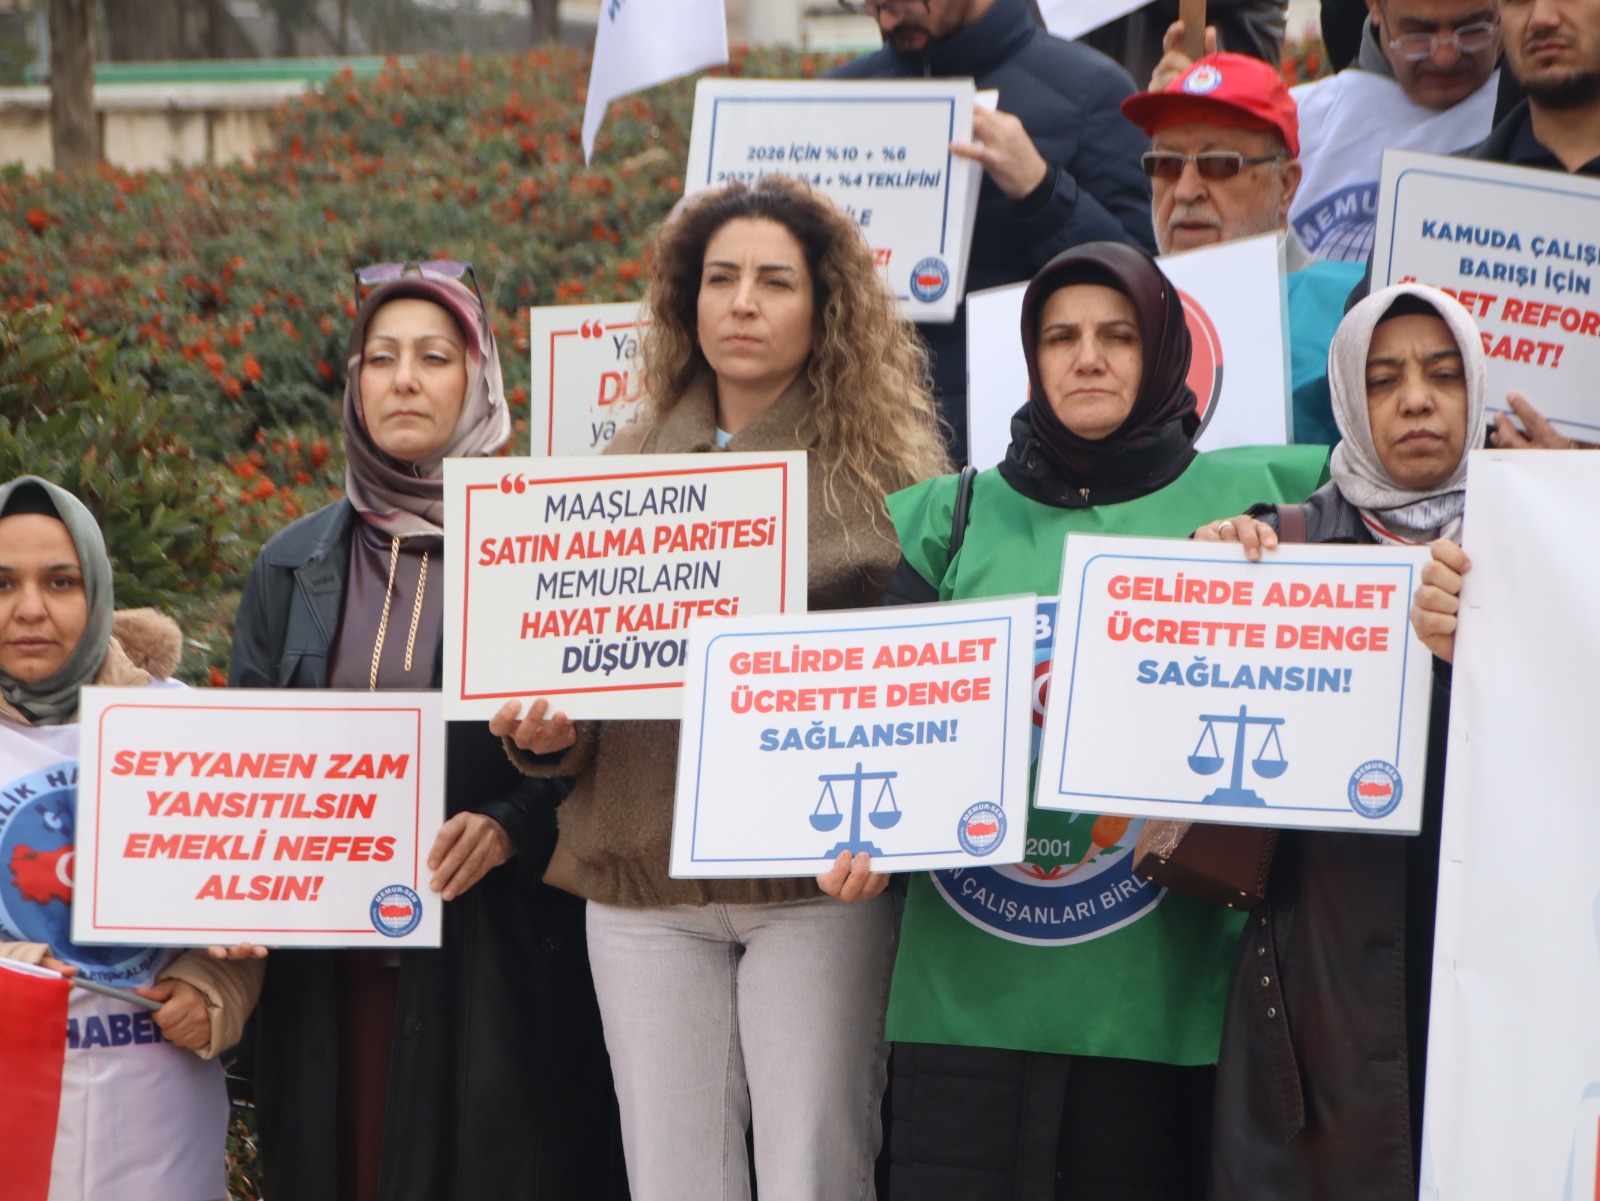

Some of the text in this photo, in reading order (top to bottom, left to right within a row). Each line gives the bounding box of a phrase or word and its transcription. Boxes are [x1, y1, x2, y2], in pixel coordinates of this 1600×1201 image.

[747, 142, 907, 163] 2026 İÇİN %10 + %6
[839, 172, 863, 187] %4
[867, 169, 942, 187] TEKLİFİNİ
[1421, 219, 1600, 266] KAMUDA ÇALIŞ
[1459, 257, 1591, 295] BARIŞI İÇİN
[1501, 297, 1600, 337] REFOR
[544, 484, 708, 524] MAAŞLARIN
[478, 516, 777, 567] SATIN ALMA PARİTESİ
[535, 560, 721, 601] MEMURLARIN
[1107, 572, 1397, 609] GELİRDE ADALET
[520, 596, 739, 640] HAYAT KALİTESİ
[1107, 611, 1389, 652] ÜCRETTE DENGE
[729, 637, 997, 676] GELİRDE ADALET
[1136, 656, 1353, 693] SAĞLANSIN!
[730, 677, 991, 714] ÜCRETTE DENGE
[759, 719, 959, 751] SAĞLANSIN!
[110, 749, 410, 779] SEYYANEN ZAM
[146, 791, 377, 819] YANSITILSIN
[962, 803, 1004, 821] MEMUR-SEN
[122, 829, 397, 862] EMEKLİ NEFES
[1026, 838, 1071, 857] 2001
[194, 875, 325, 901] ALSIN!
[375, 886, 418, 903] MEMUR-SEN
[961, 877, 1096, 924] ÇALIŞANLARI
